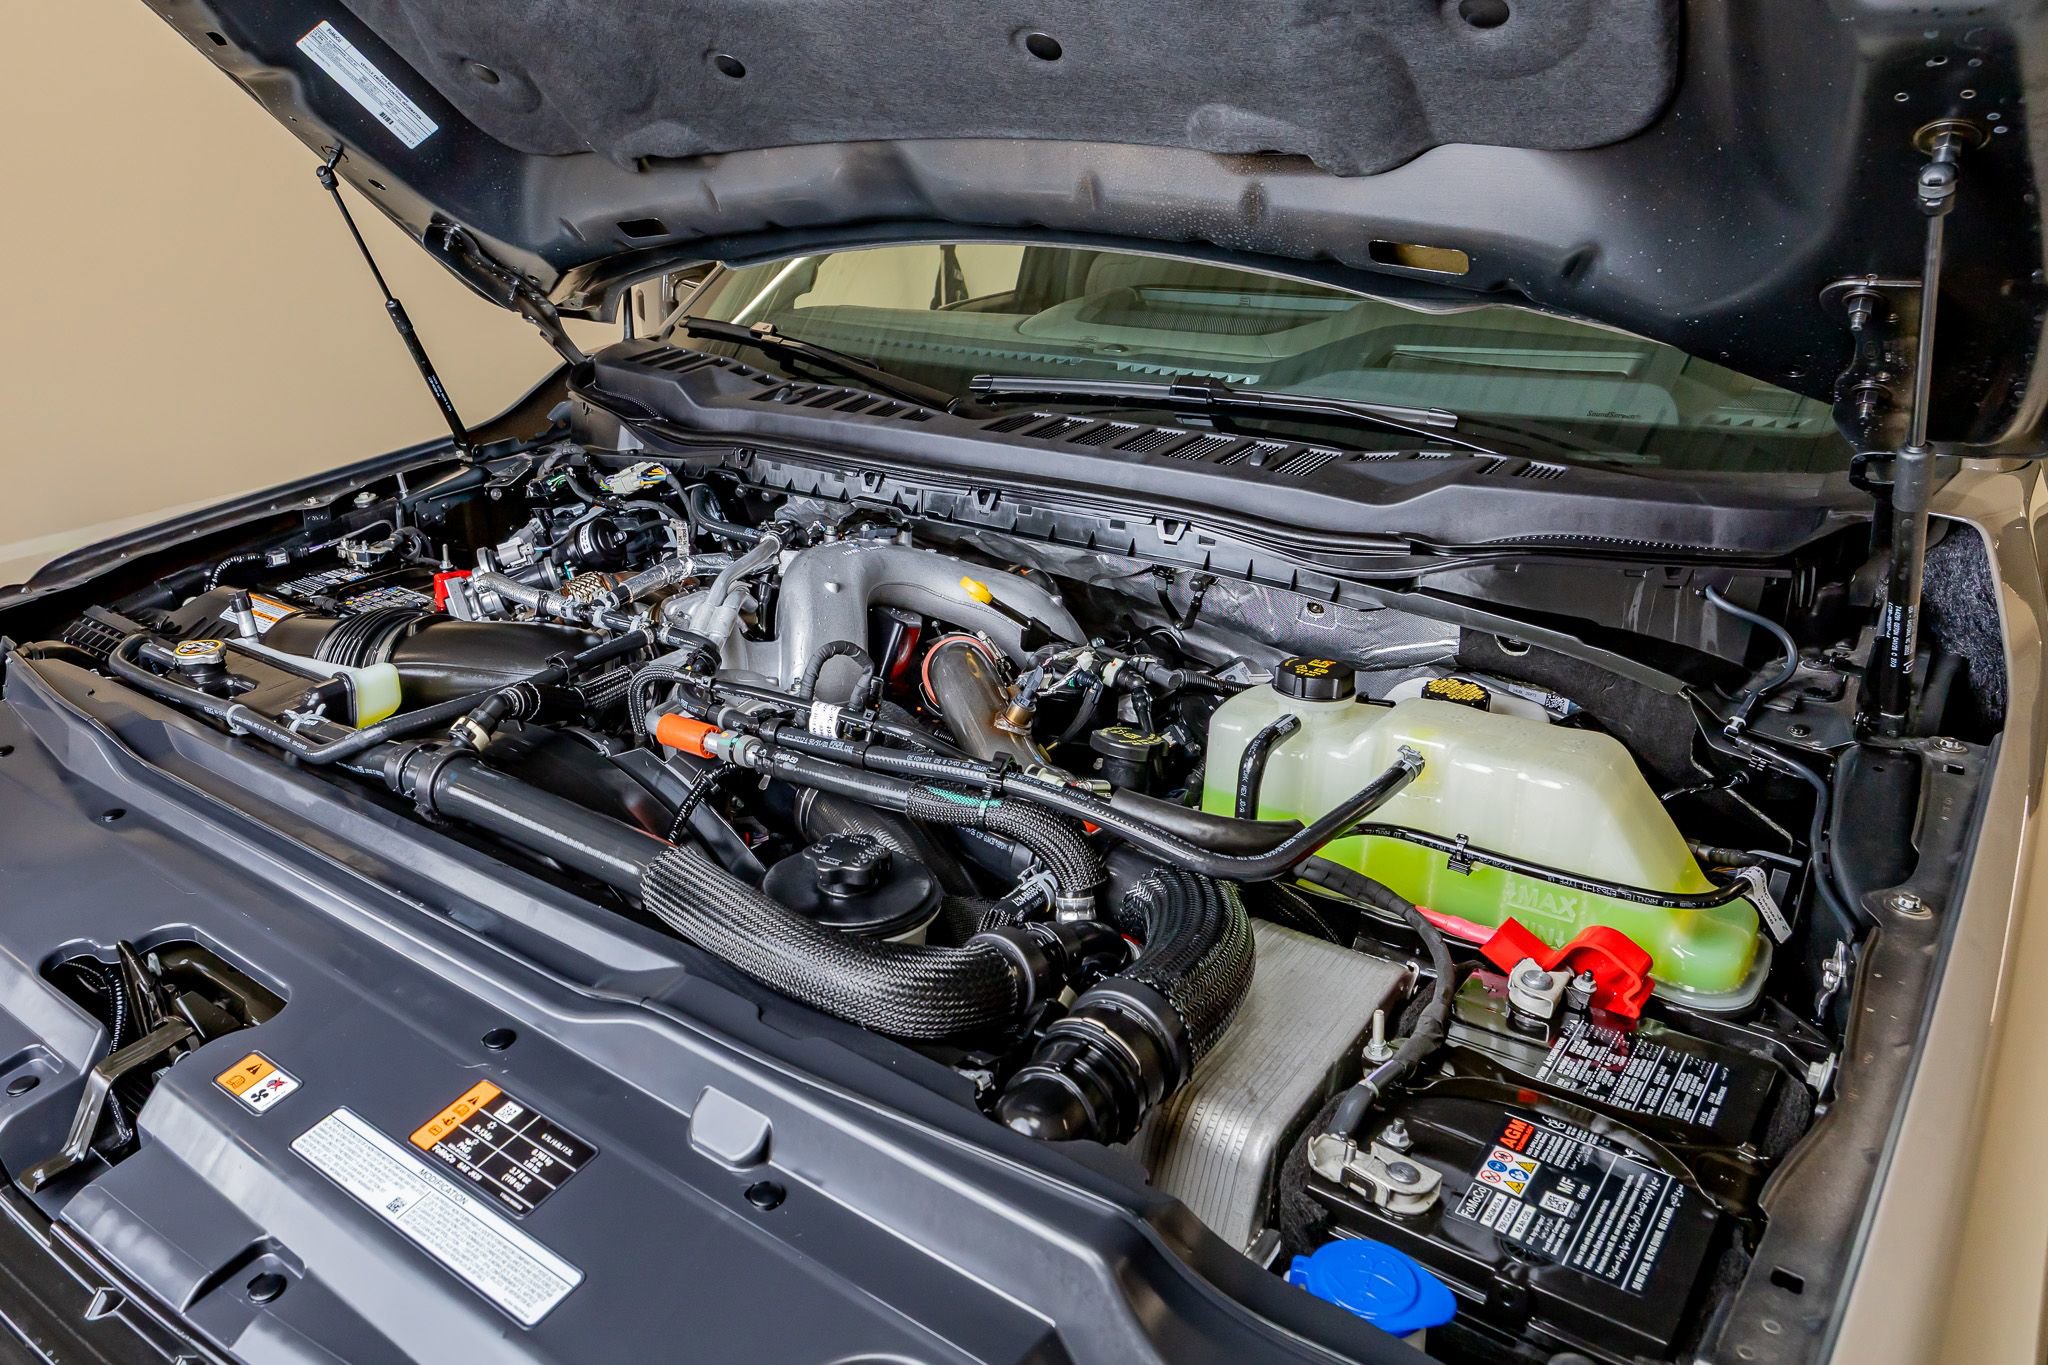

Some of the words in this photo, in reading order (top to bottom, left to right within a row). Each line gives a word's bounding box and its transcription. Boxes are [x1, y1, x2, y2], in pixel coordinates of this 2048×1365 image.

[1499, 1117, 1527, 1148] AGM
[431, 1145, 457, 1163] FoMoCo
[419, 1169, 468, 1204] MODIFICATION
[1460, 1185, 1487, 1218] FoMoCo
[1556, 1177, 1577, 1195] MF
